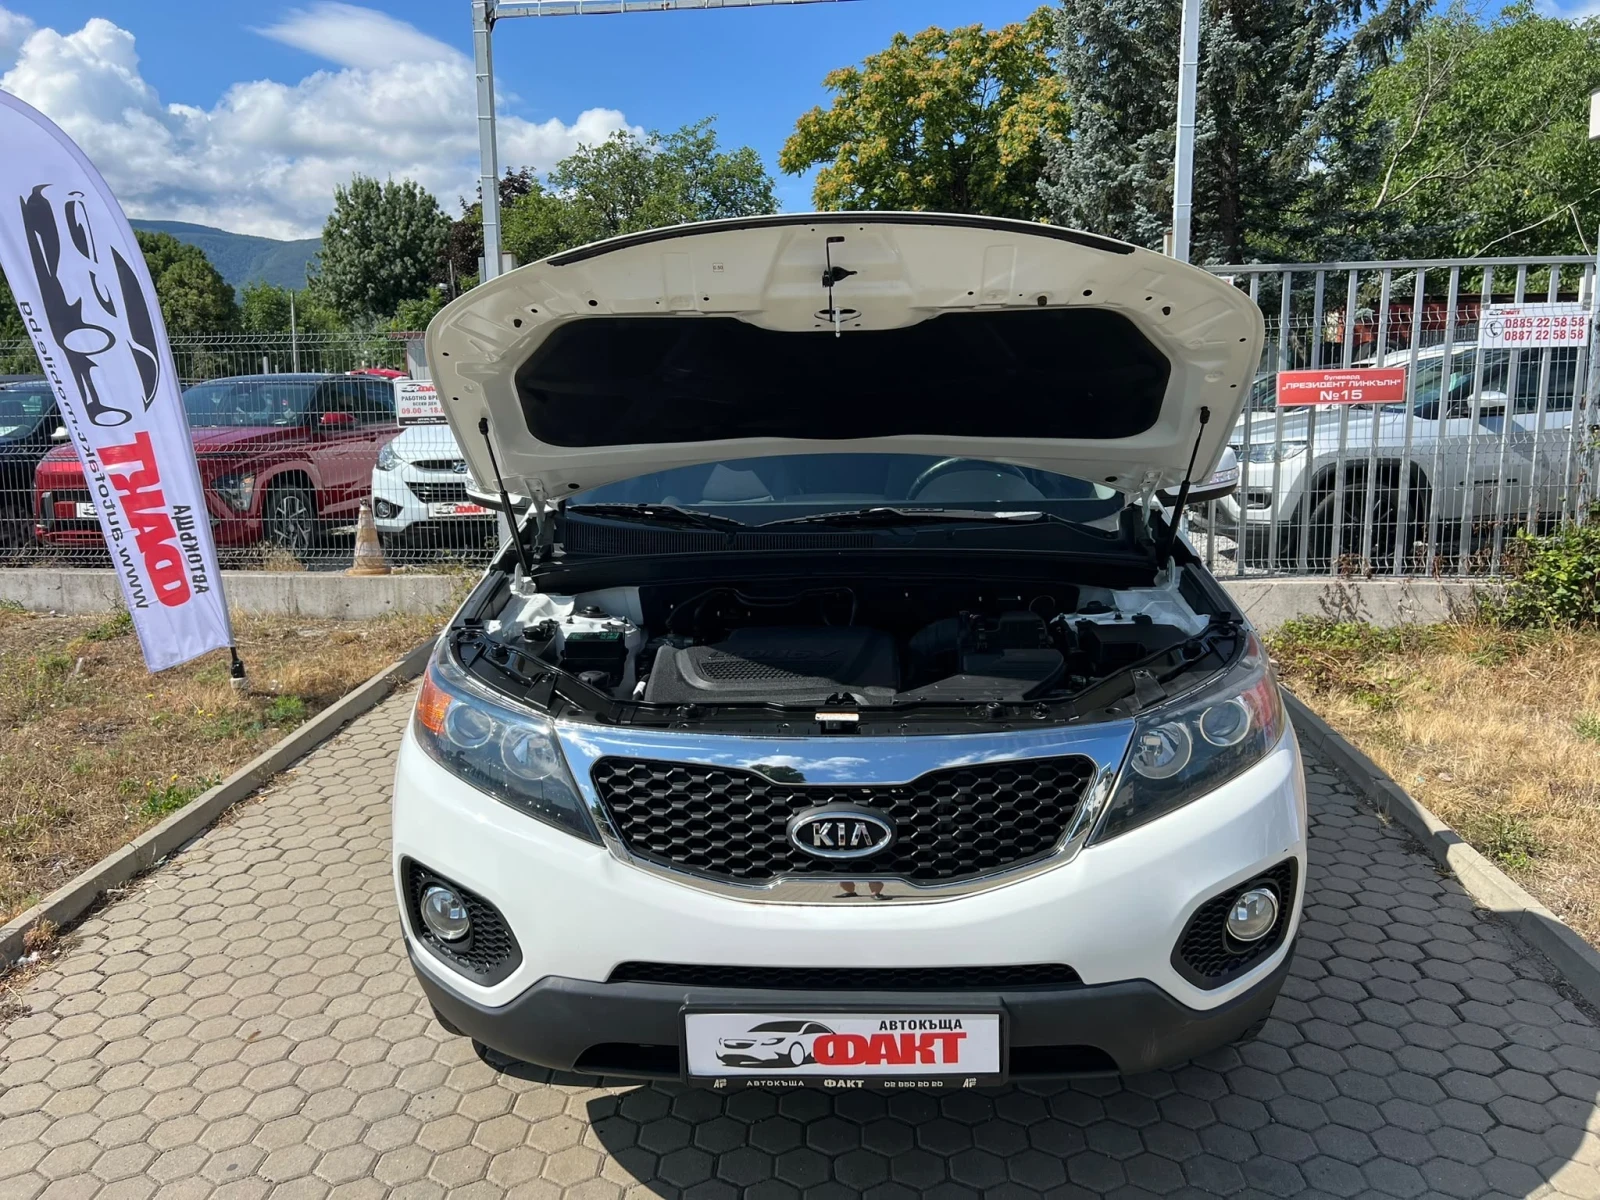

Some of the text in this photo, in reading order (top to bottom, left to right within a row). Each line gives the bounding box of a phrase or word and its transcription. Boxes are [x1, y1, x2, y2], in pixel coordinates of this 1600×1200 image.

[1505, 316, 1585, 328] 0885 22 58 58
[1504, 330, 1584, 341] 0887 22 58 58
[812, 823, 873, 846] KIA
[879, 1019, 962, 1031] АВТОКЪЩА
[813, 1032, 967, 1066] ФАКТ
[823, 1079, 865, 1088] ФАКТ
